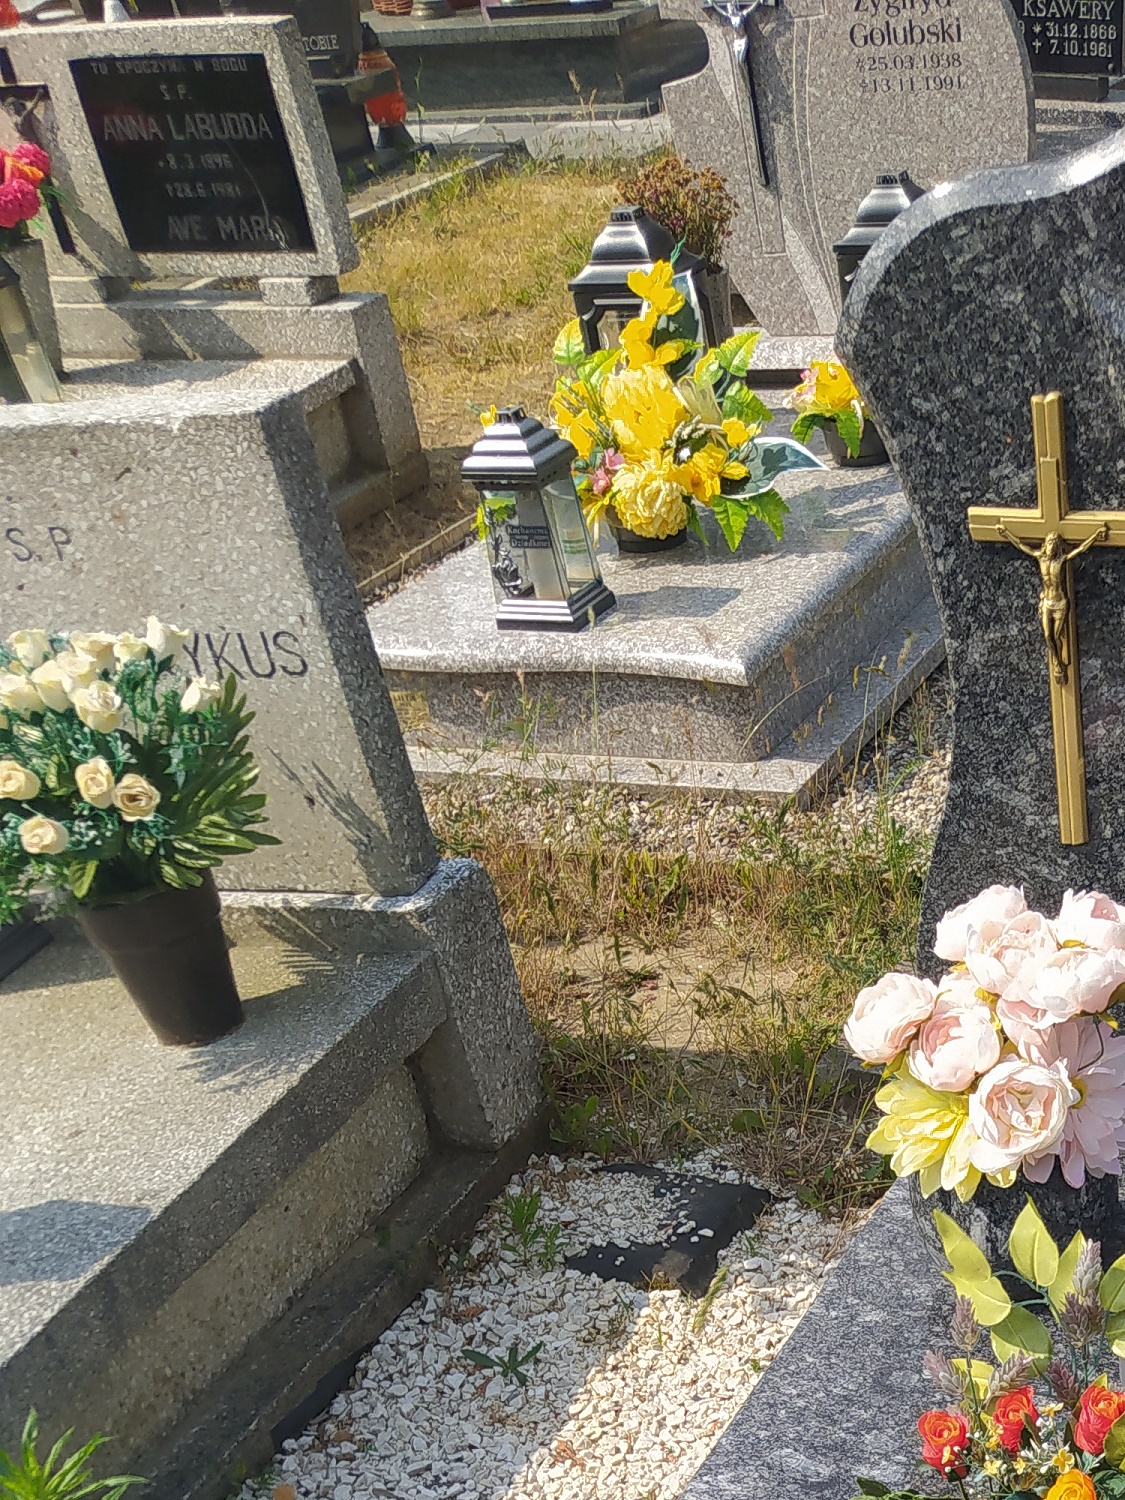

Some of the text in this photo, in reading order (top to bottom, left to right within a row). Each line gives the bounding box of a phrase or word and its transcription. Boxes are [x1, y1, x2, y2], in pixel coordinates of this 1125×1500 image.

[1022, 0, 1115, 20] KSAWERY
[302, 35, 339, 50] TOBIE
[849, 17, 962, 48] Golubski
[104, 115, 164, 141] ANNA
[180, 629, 308, 680] YKUS
